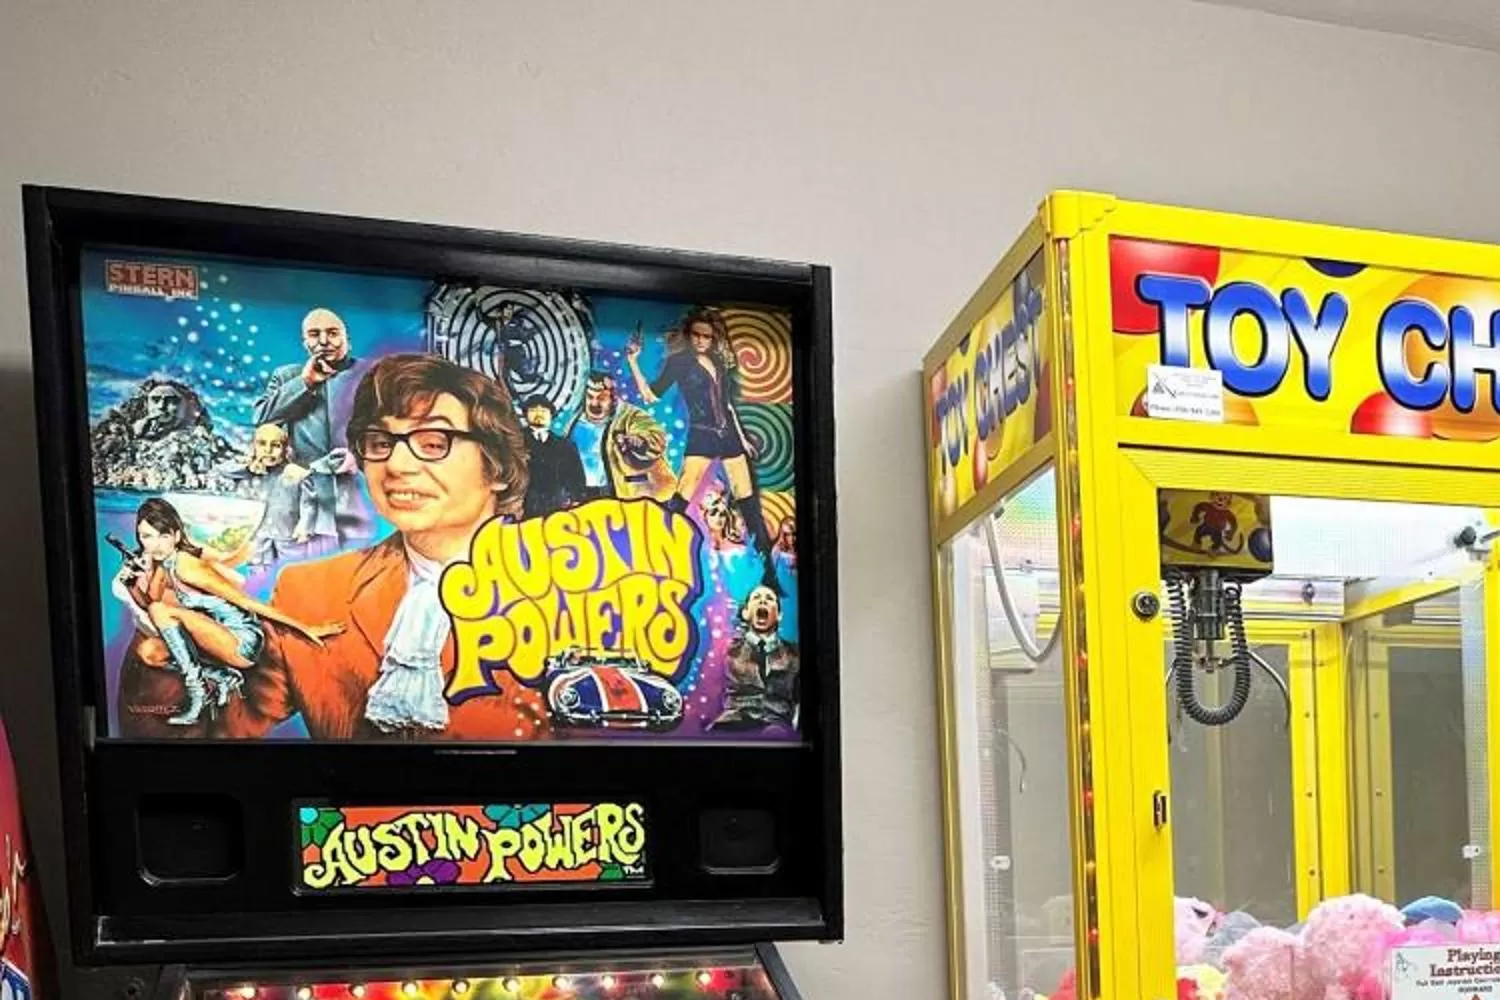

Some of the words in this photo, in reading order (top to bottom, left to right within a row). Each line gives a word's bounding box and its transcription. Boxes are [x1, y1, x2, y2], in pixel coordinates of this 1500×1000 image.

[108, 263, 195, 289] STERN
[1134, 272, 1349, 401] TOY
[935, 369, 969, 476] TOY
[974, 286, 1043, 440] CHEST
[440, 498, 695, 622] AUSTIN
[444, 572, 690, 698] POWERS
[303, 812, 481, 888] AUSTIN
[482, 802, 646, 883] POWERS
